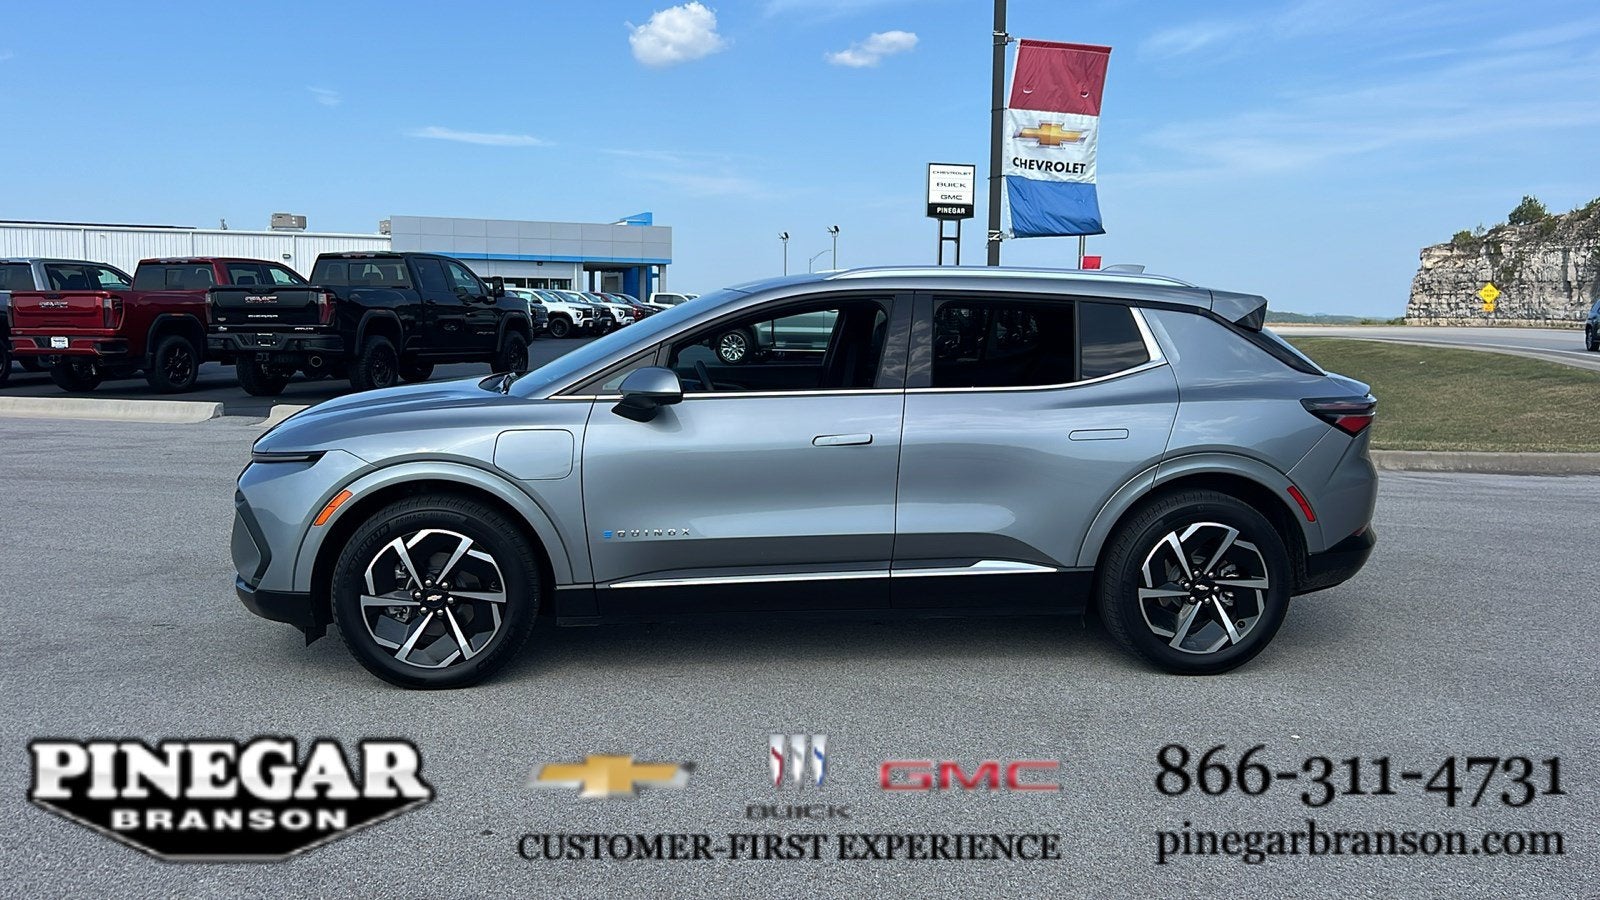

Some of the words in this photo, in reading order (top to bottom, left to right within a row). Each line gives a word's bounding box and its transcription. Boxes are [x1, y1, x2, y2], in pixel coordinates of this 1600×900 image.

[1012, 156, 1086, 174] CHEVROLET
[936, 206, 966, 214] PINEGAR
[603, 527, 690, 539] EQUINOX
